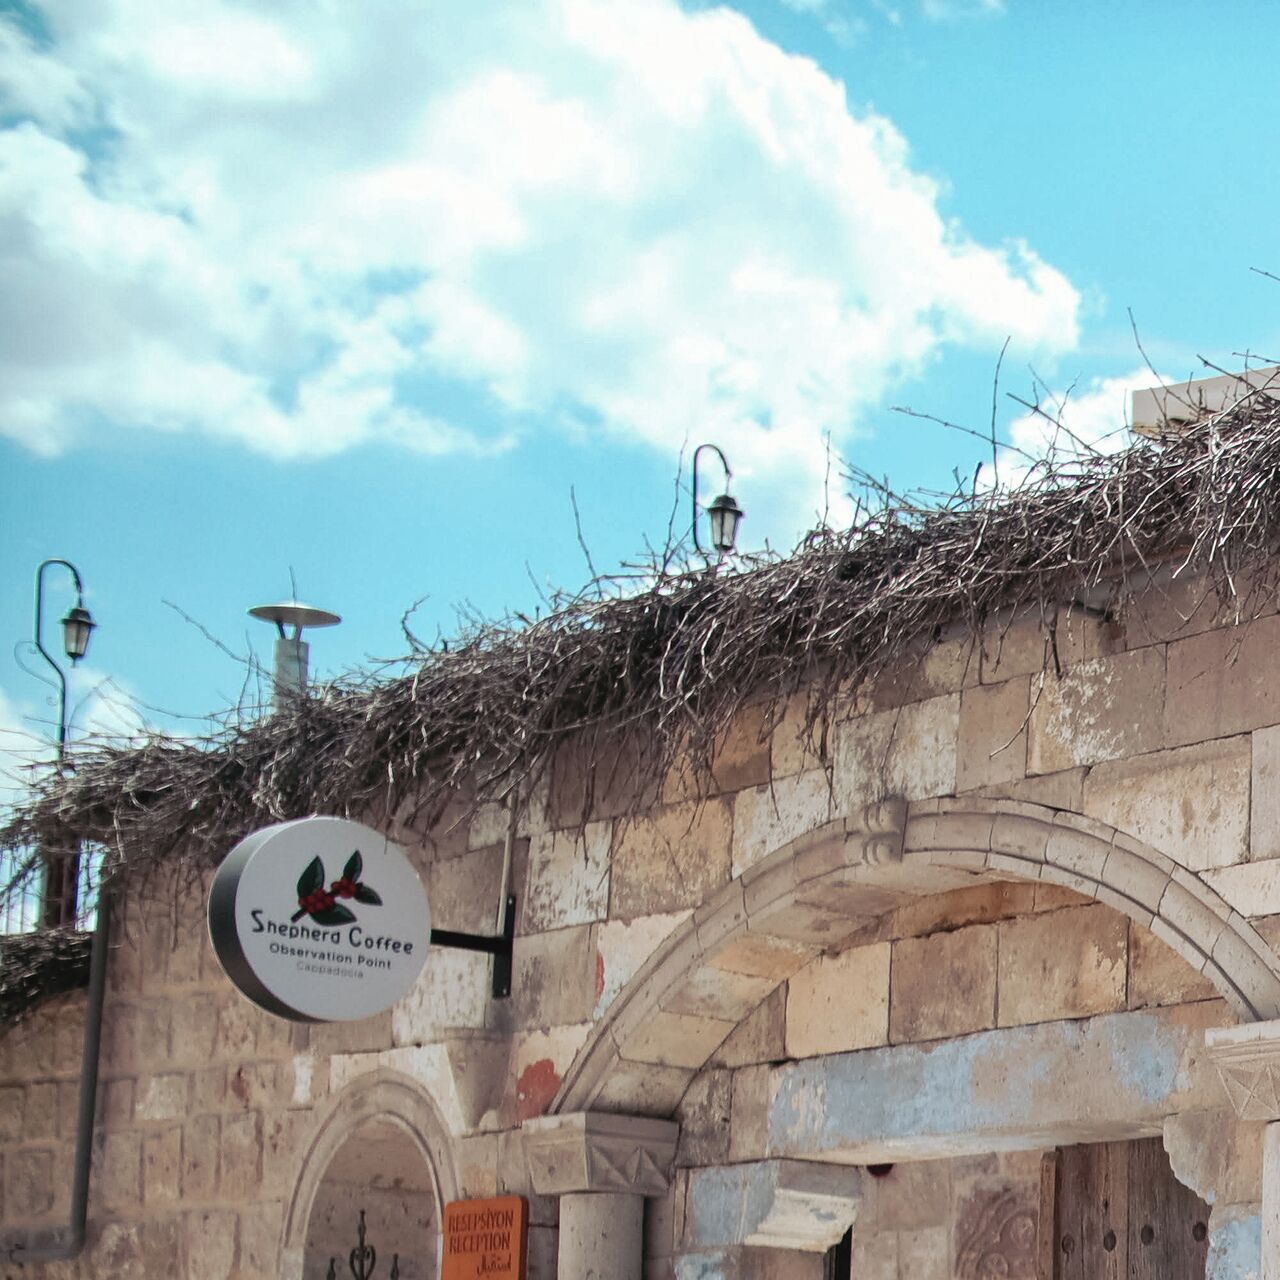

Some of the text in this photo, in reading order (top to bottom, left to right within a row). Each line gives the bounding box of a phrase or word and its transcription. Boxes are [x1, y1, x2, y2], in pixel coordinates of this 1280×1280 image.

[251, 909, 414, 955] Shepherd Coffee
[269, 942, 392, 970] Observation Point
[449, 1231, 511, 1255] RECEPTION
